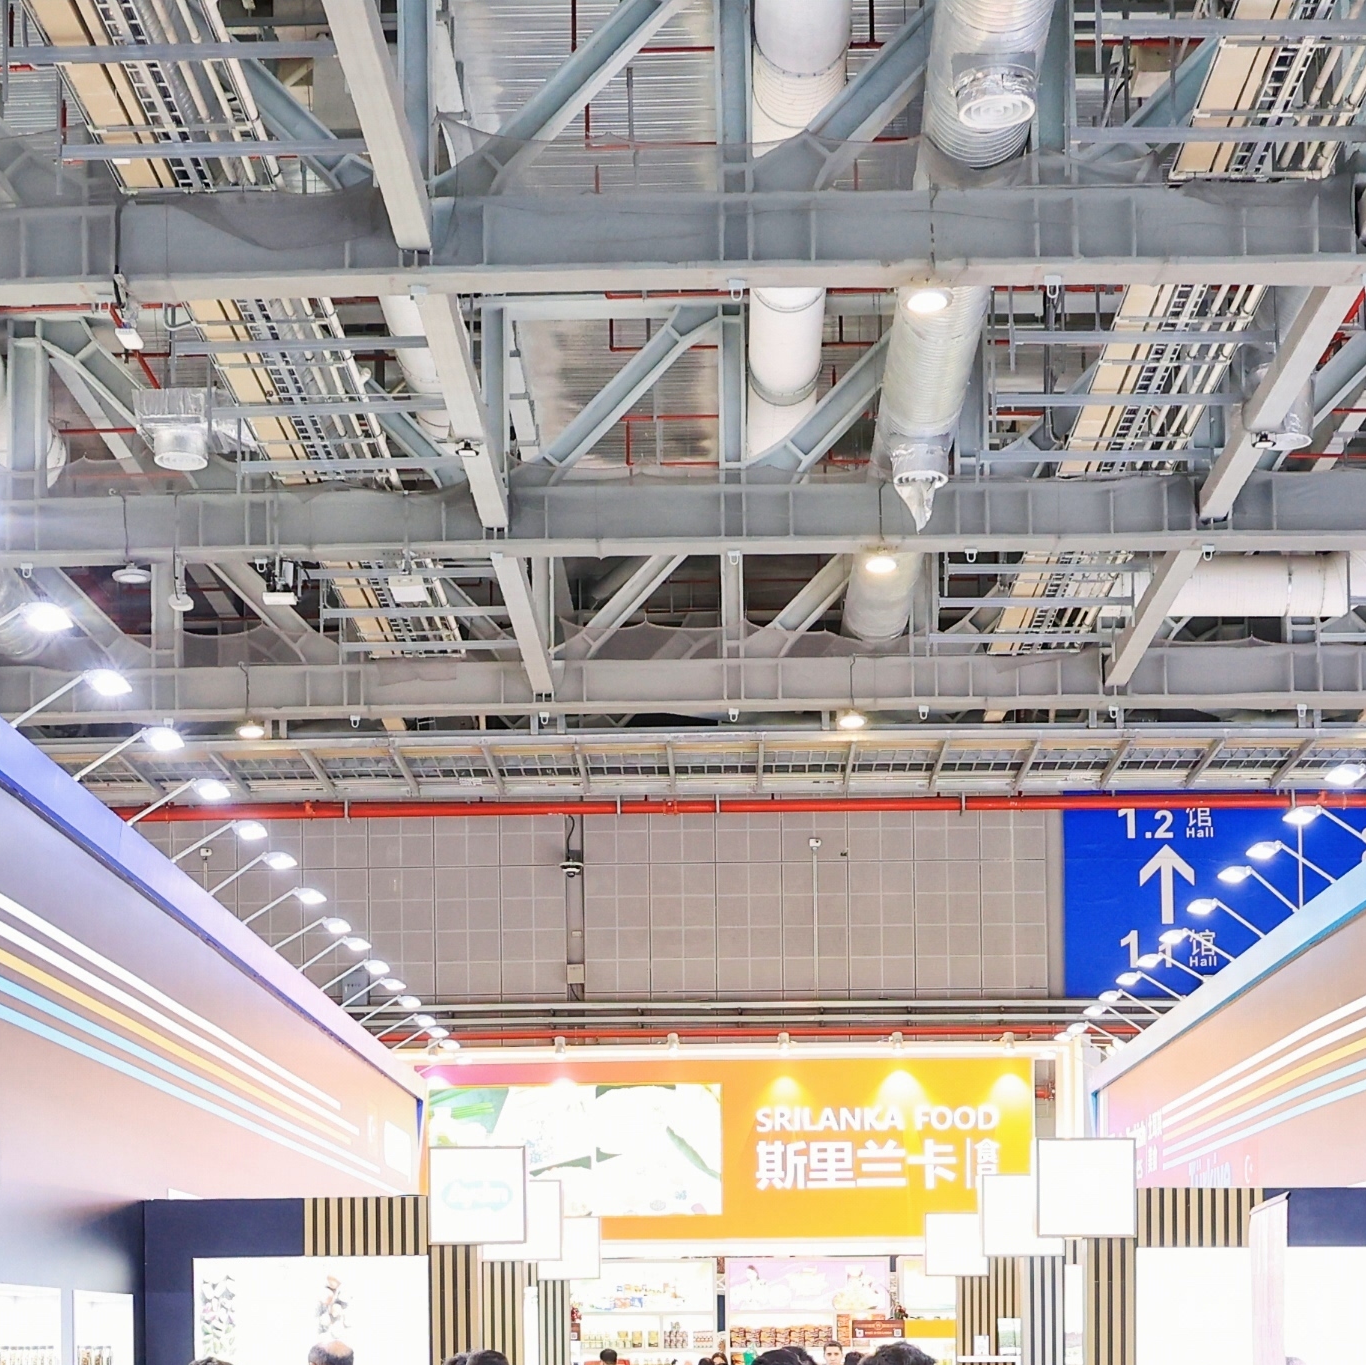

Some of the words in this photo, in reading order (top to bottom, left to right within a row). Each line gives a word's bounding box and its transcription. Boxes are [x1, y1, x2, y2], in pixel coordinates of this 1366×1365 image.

[1118, 808, 1174, 839] 1.2
[1186, 827, 1213, 838] Hall
[1189, 956, 1217, 967] Hall
[755, 1106, 905, 1132] SRILANKA
[915, 1105, 1000, 1131] FOOD
[756, 1138, 957, 1190] 斯里兰卡
